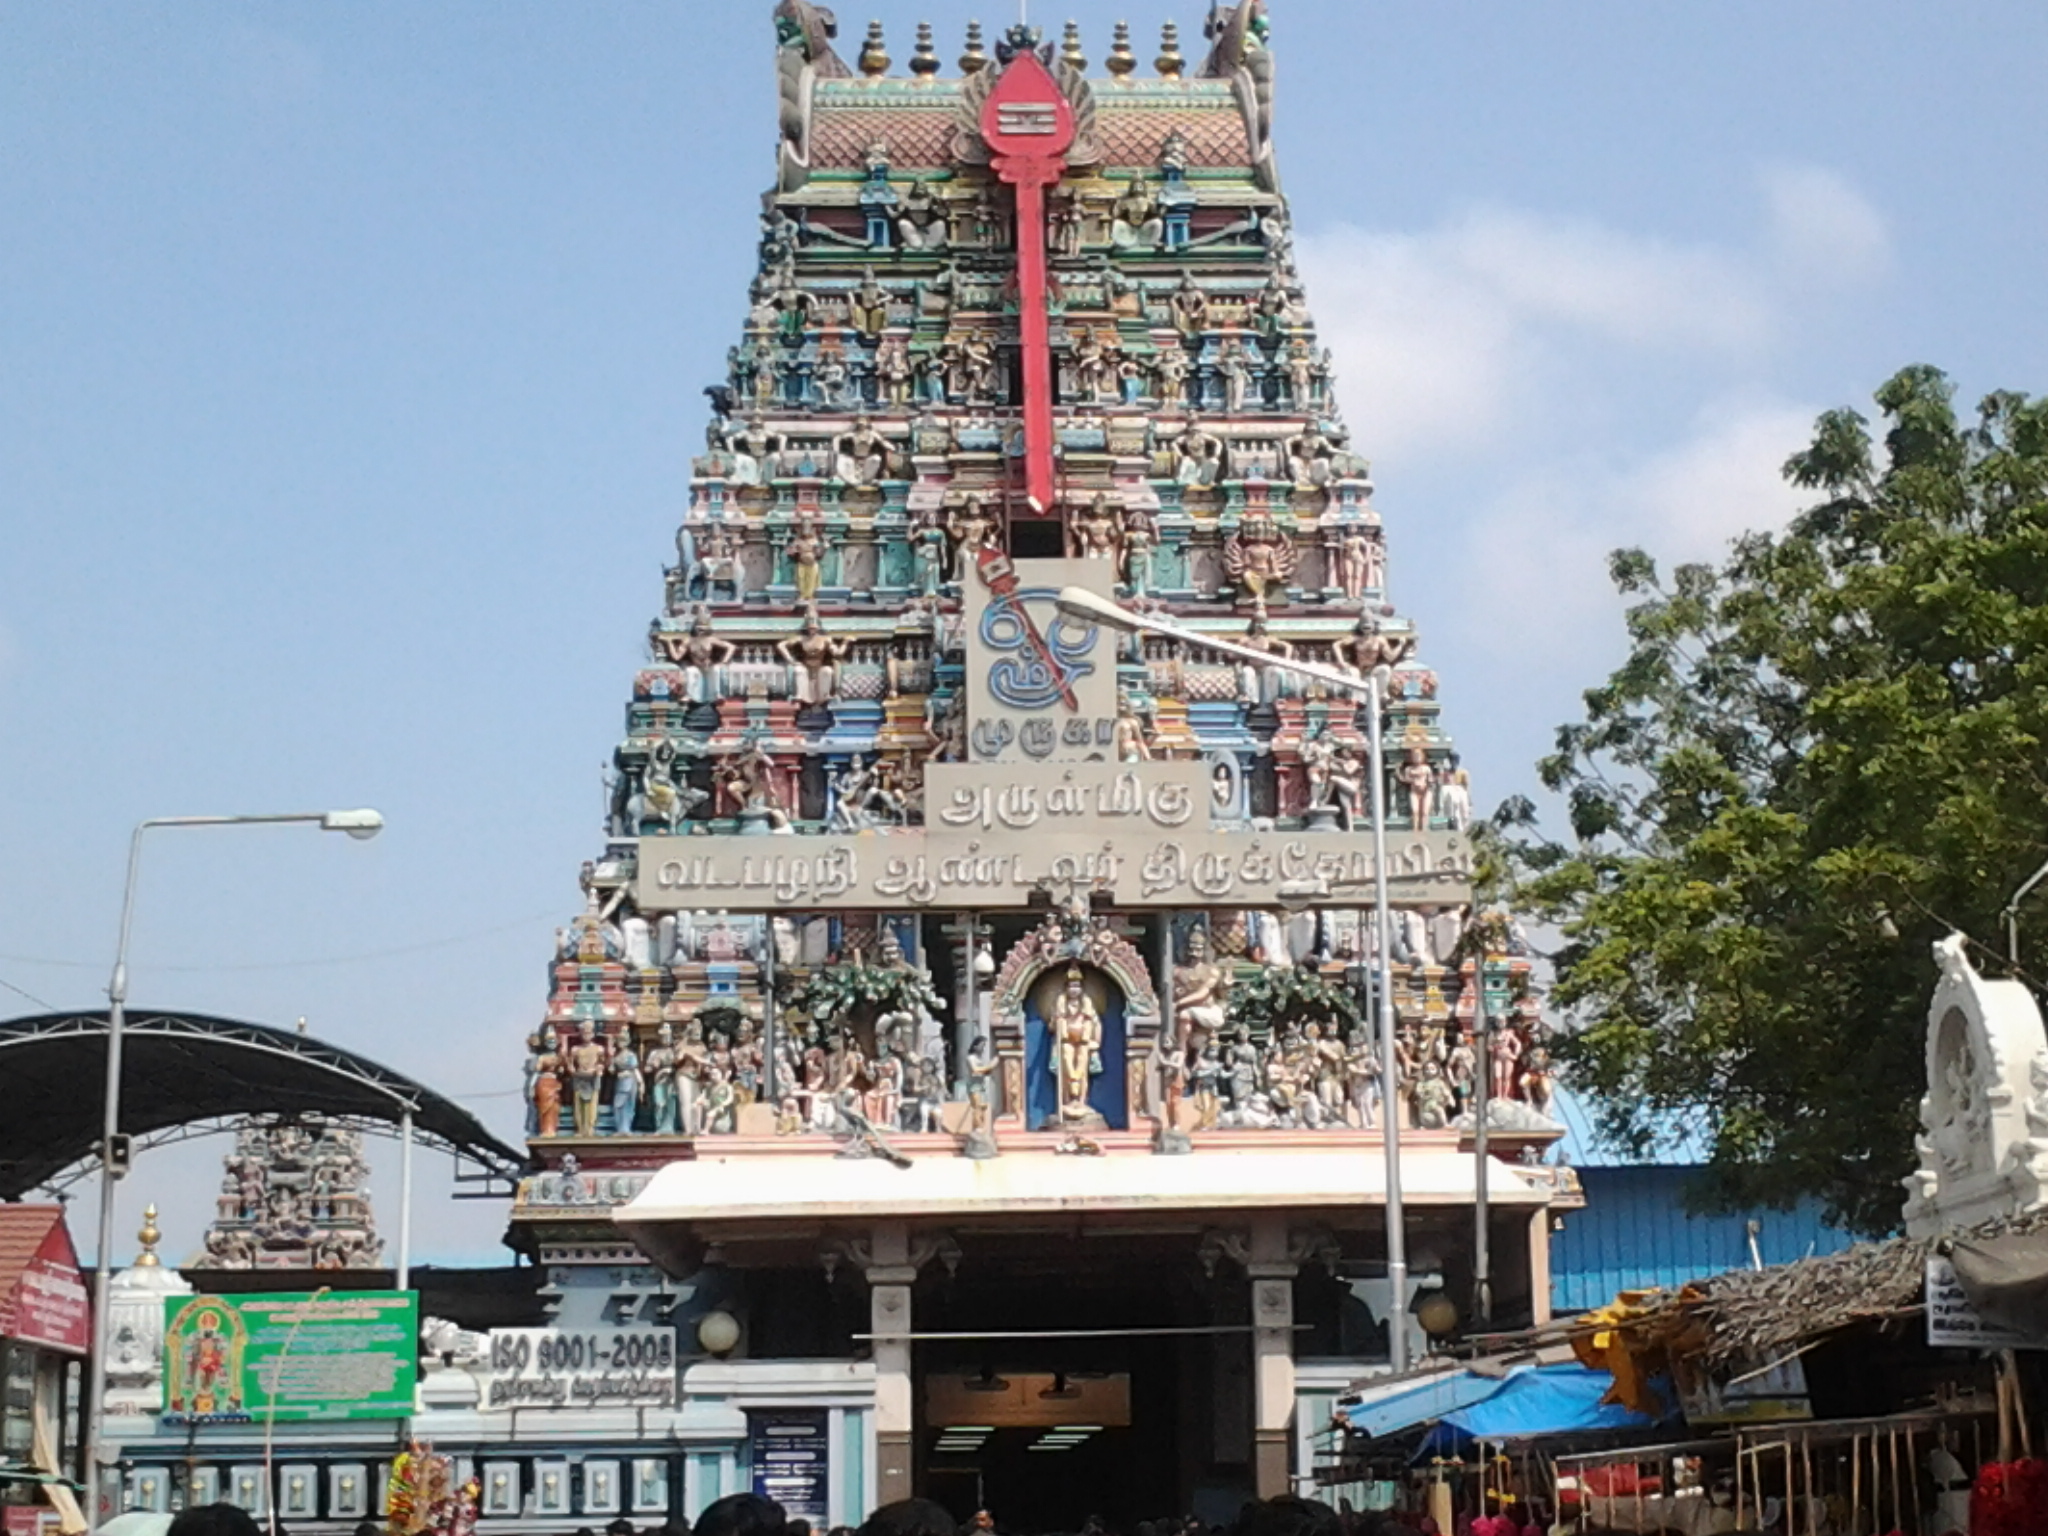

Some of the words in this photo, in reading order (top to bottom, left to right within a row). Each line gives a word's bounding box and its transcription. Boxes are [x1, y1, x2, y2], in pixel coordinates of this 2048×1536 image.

[940, 769, 1194, 829] அருள்மிகு
[657, 844, 859, 902] வடபழநி
[873, 839, 1124, 902] ஆண்டவர்
[491, 1333, 531, 1370] ISO
